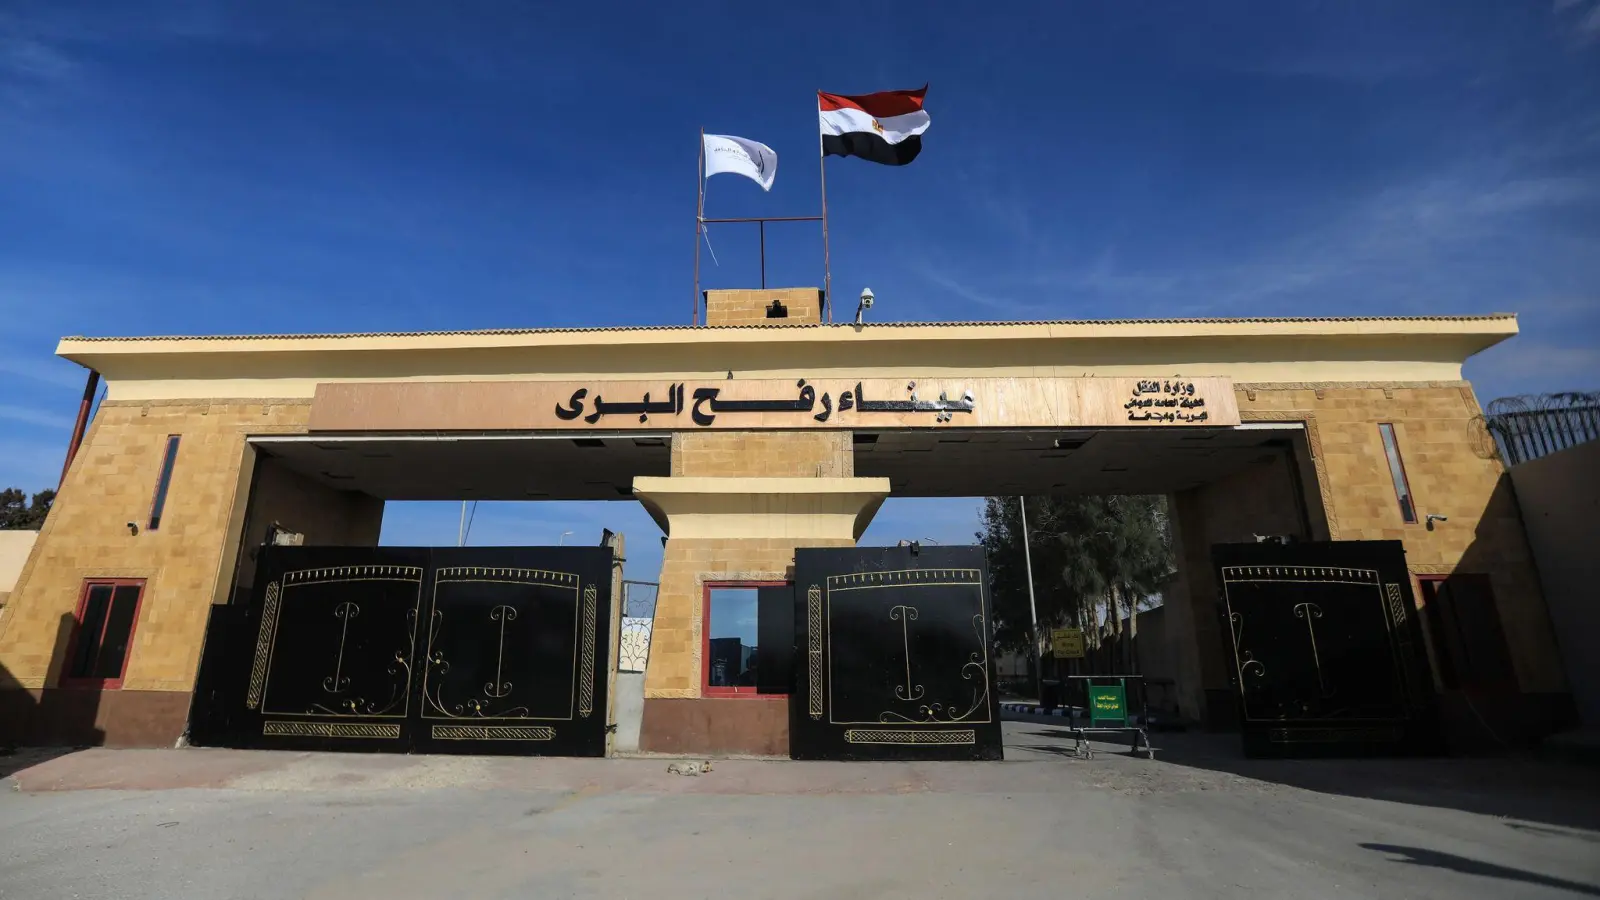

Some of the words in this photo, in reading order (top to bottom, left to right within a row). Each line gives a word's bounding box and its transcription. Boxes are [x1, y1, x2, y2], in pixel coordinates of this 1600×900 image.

[692, 378, 832, 427] رفح
[838, 380, 976, 423] ميناء
[1132, 380, 1160, 396] النقل
[1163, 381, 1195, 396] وزارة
